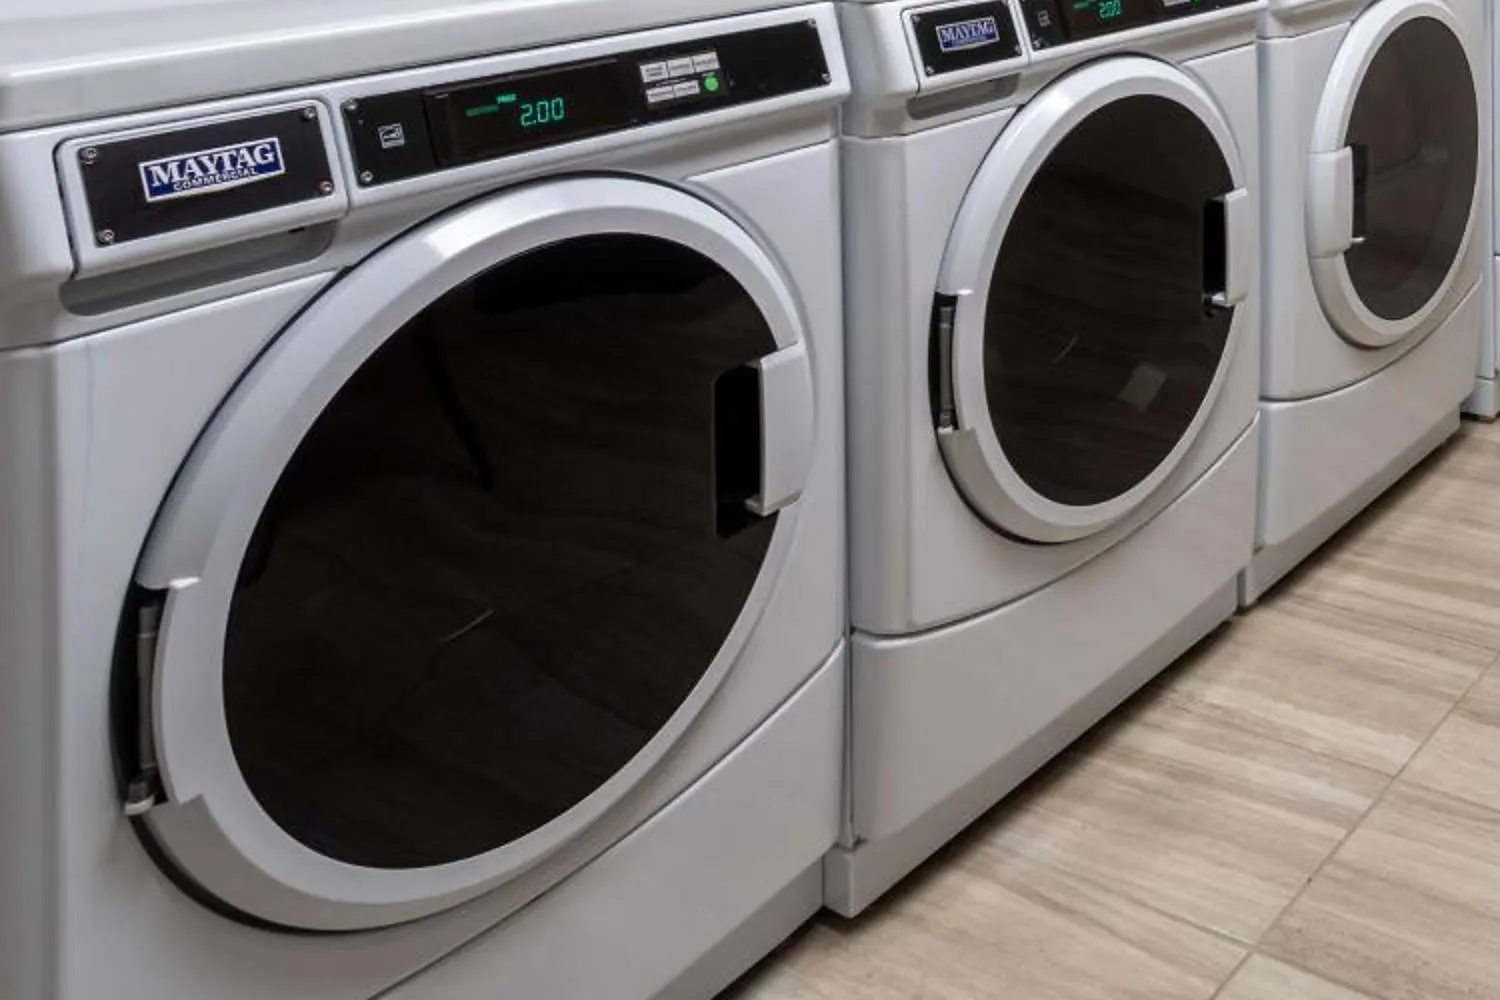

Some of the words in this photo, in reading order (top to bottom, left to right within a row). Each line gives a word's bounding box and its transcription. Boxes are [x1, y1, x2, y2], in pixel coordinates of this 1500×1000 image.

[520, 97, 565, 127] 2.00
[148, 143, 275, 187] MAYTAG
[173, 166, 258, 191] COMMERCIAL
